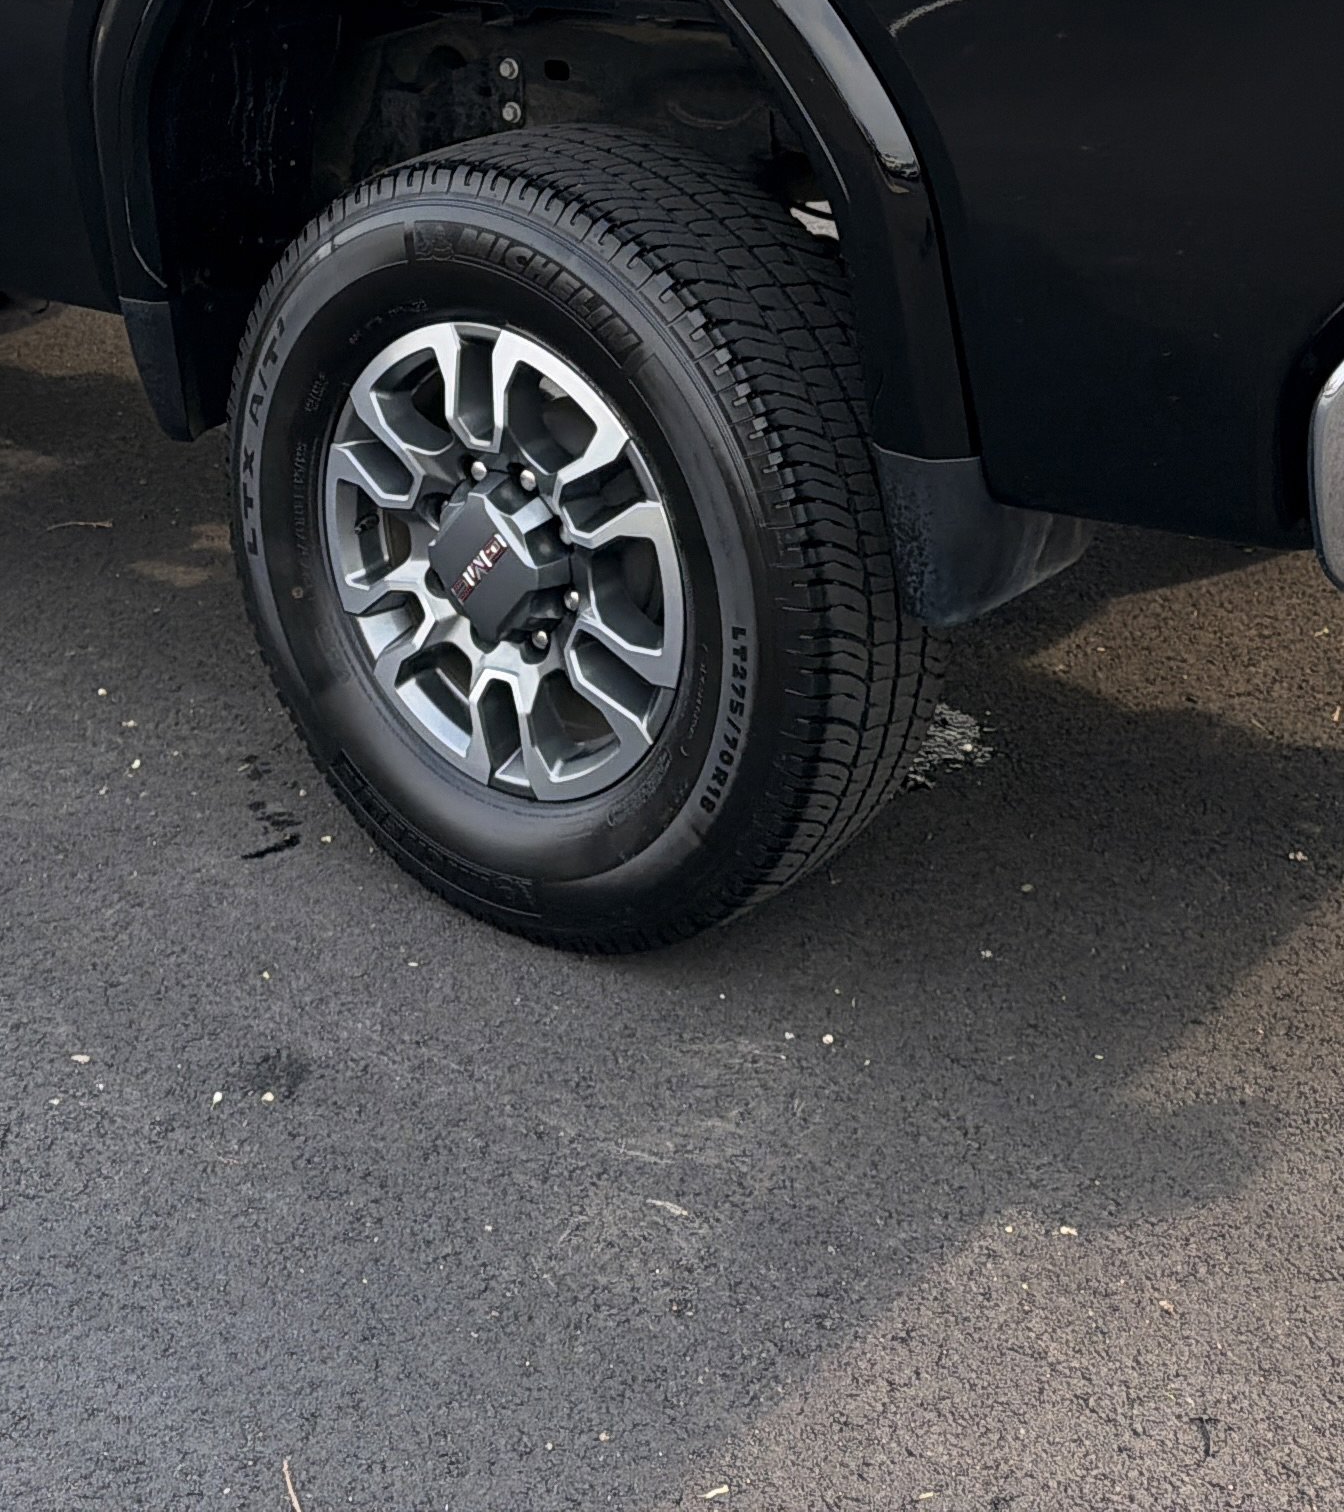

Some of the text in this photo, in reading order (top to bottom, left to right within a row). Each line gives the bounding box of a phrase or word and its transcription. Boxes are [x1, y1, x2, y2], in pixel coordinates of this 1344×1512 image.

[458, 226, 644, 358] MICHELIN
[241, 445, 258, 556] LTX
[451, 533, 508, 606] GMC
[699, 626, 749, 814] LT275/70R18
